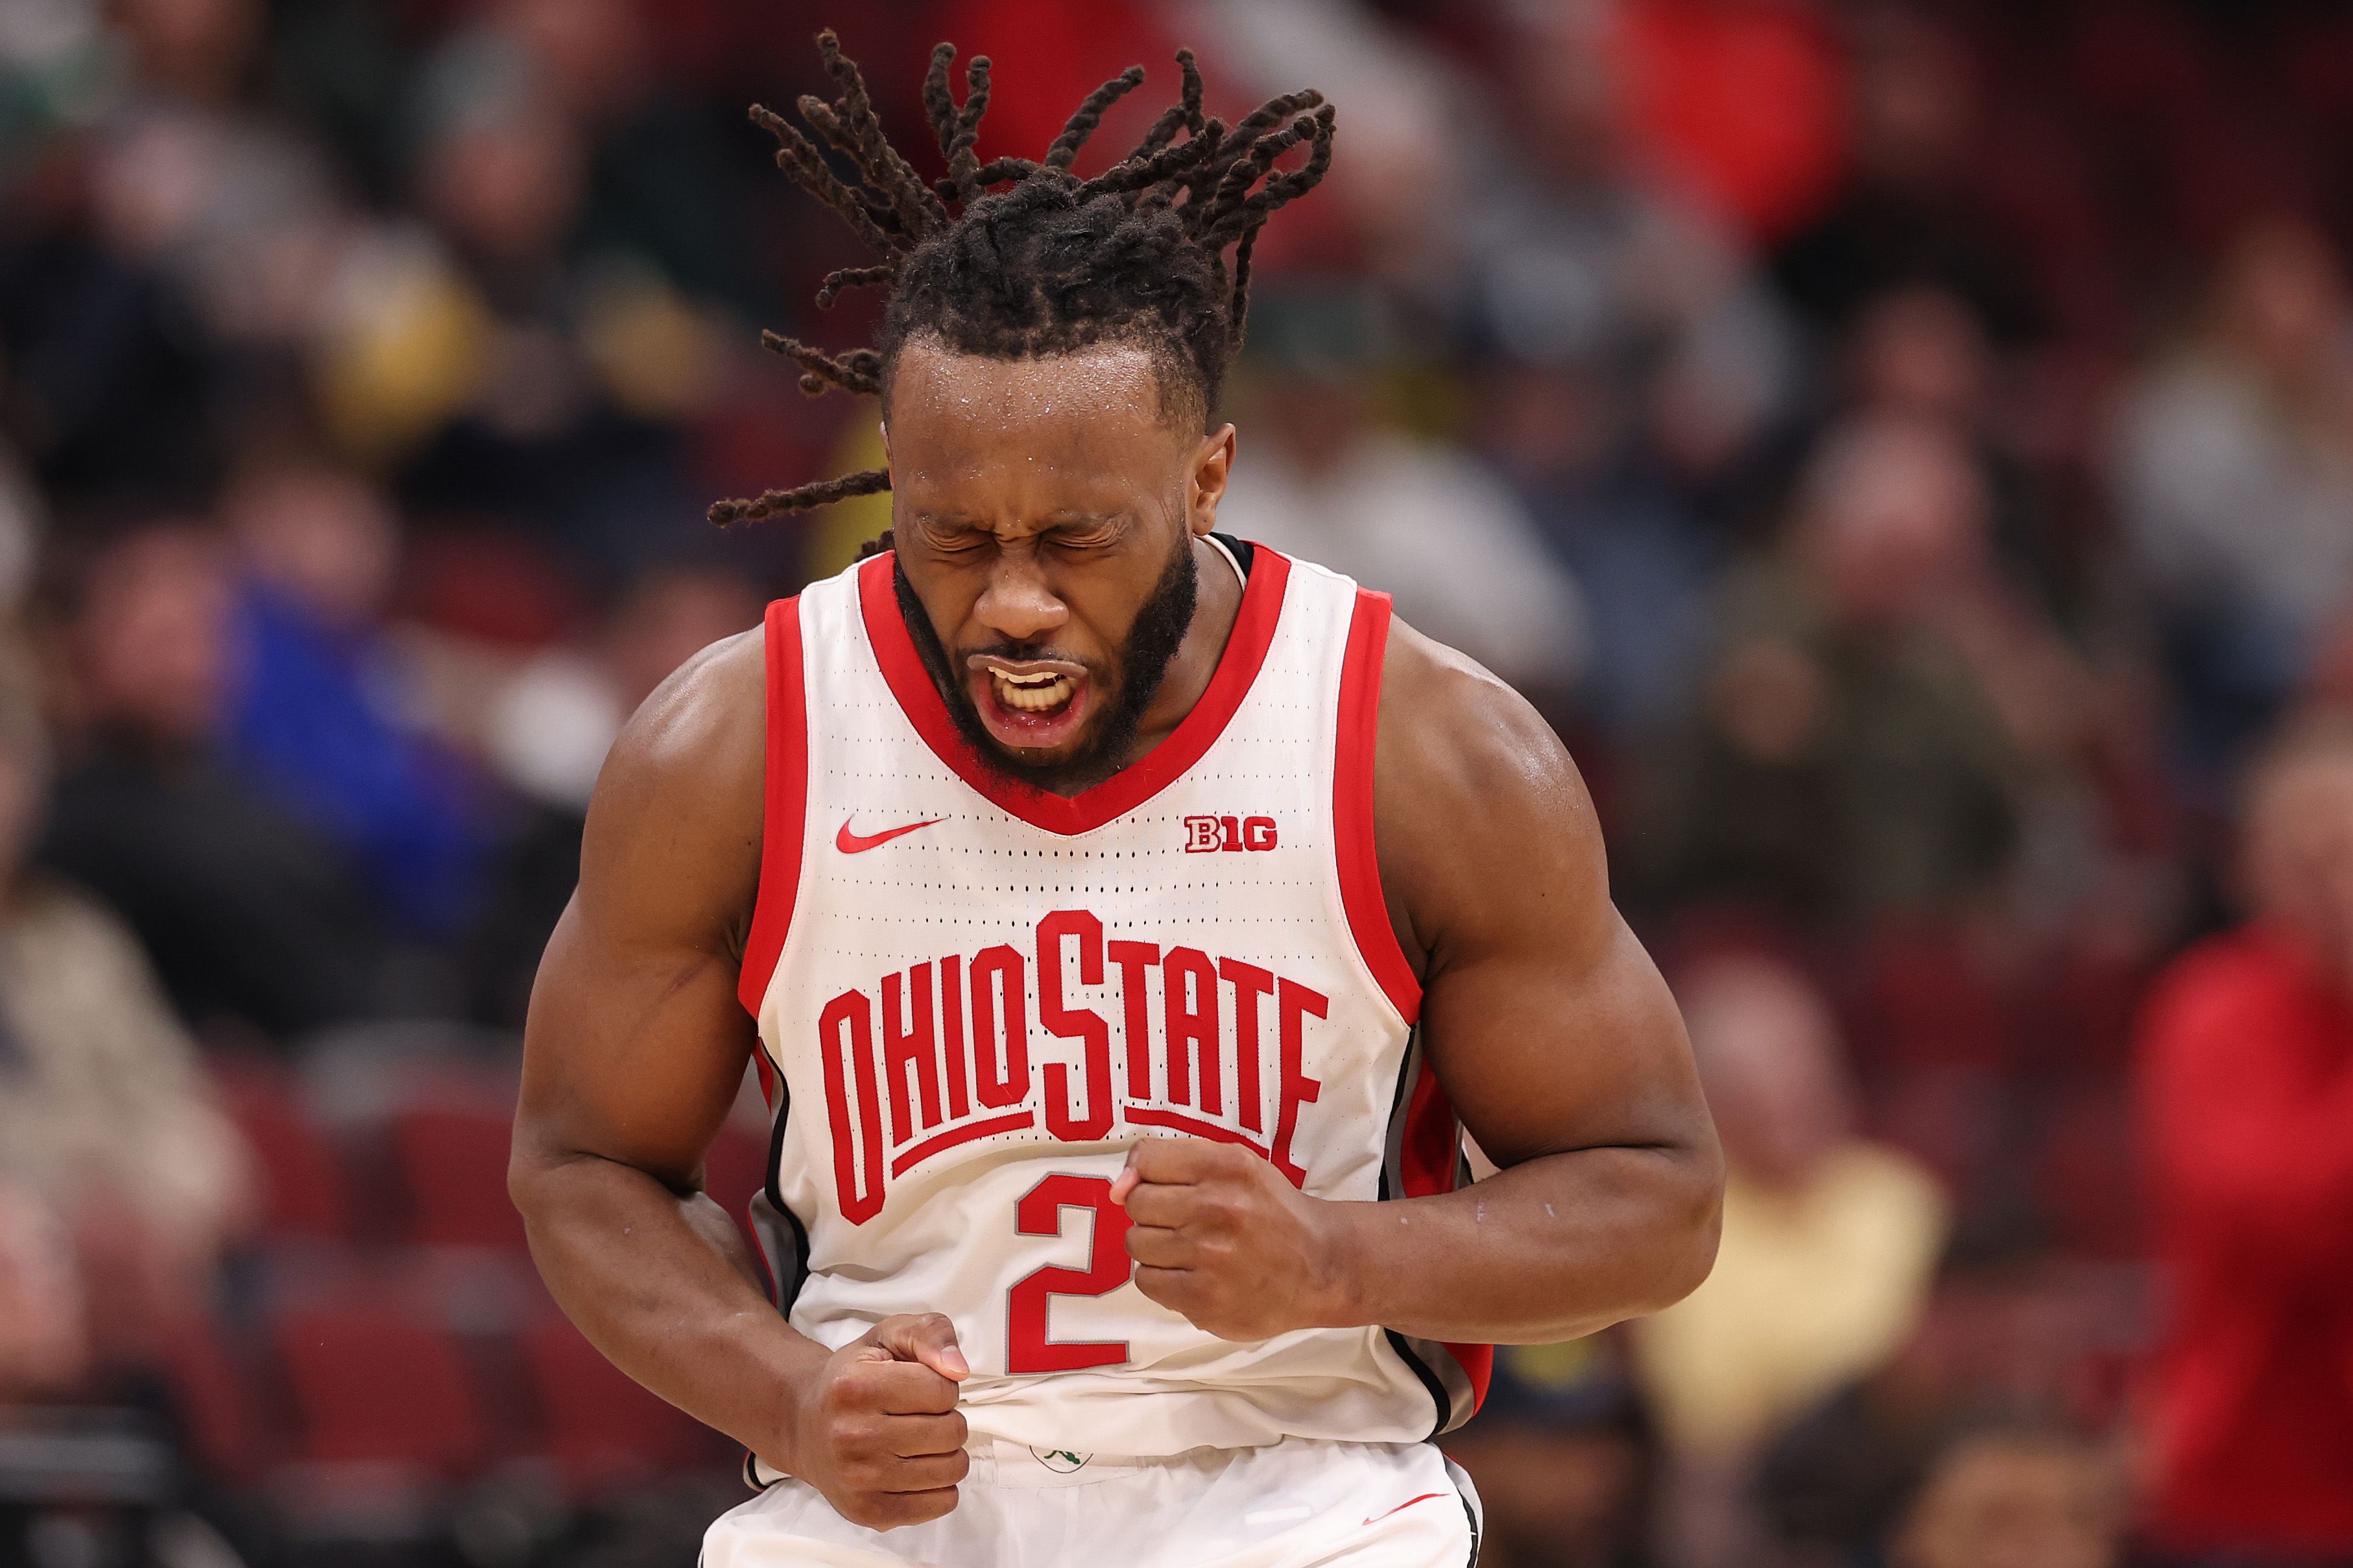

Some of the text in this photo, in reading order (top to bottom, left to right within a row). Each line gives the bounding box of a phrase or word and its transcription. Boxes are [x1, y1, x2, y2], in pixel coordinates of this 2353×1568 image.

[819, 910, 1328, 1225] OHIO STATE
[1005, 1172, 1135, 1375] 2
